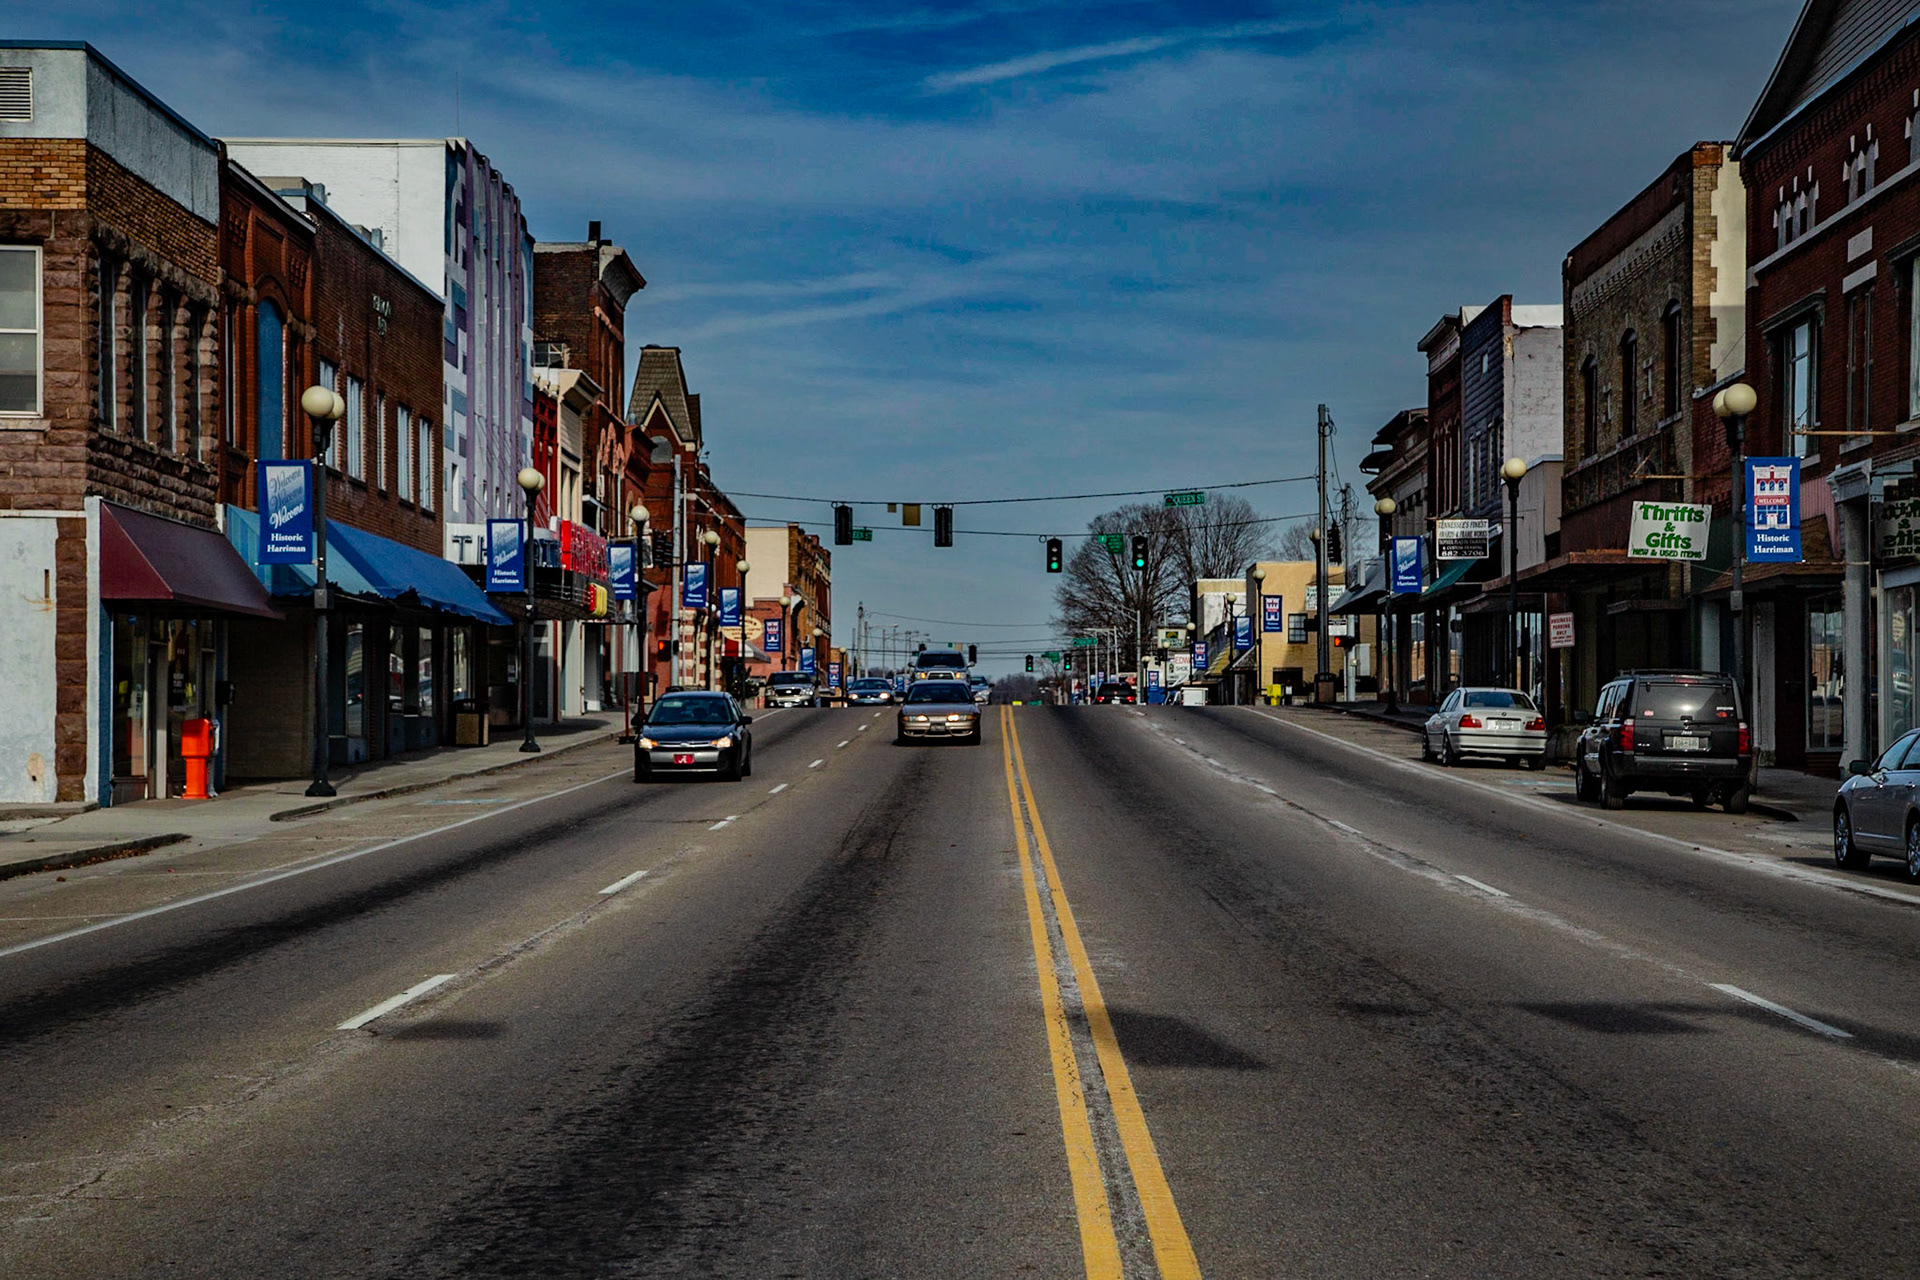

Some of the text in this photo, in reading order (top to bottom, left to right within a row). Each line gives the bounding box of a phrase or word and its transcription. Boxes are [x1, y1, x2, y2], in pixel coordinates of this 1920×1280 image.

[1174, 493, 1195, 505] QUEEN
[269, 503, 304, 529] Welcome
[1640, 504, 1704, 522] Thrifts
[1664, 522, 1676, 532] &
[271, 533, 303, 541] Historic
[1646, 533, 1692, 549] Gifts
[1757, 534, 1790, 542] Historic
[267, 544, 306, 552] Harriman
[1754, 545, 1794, 553] Harriman
[1659, 549, 1678, 557] USED
[1680, 550, 1702, 558] ITEMS
